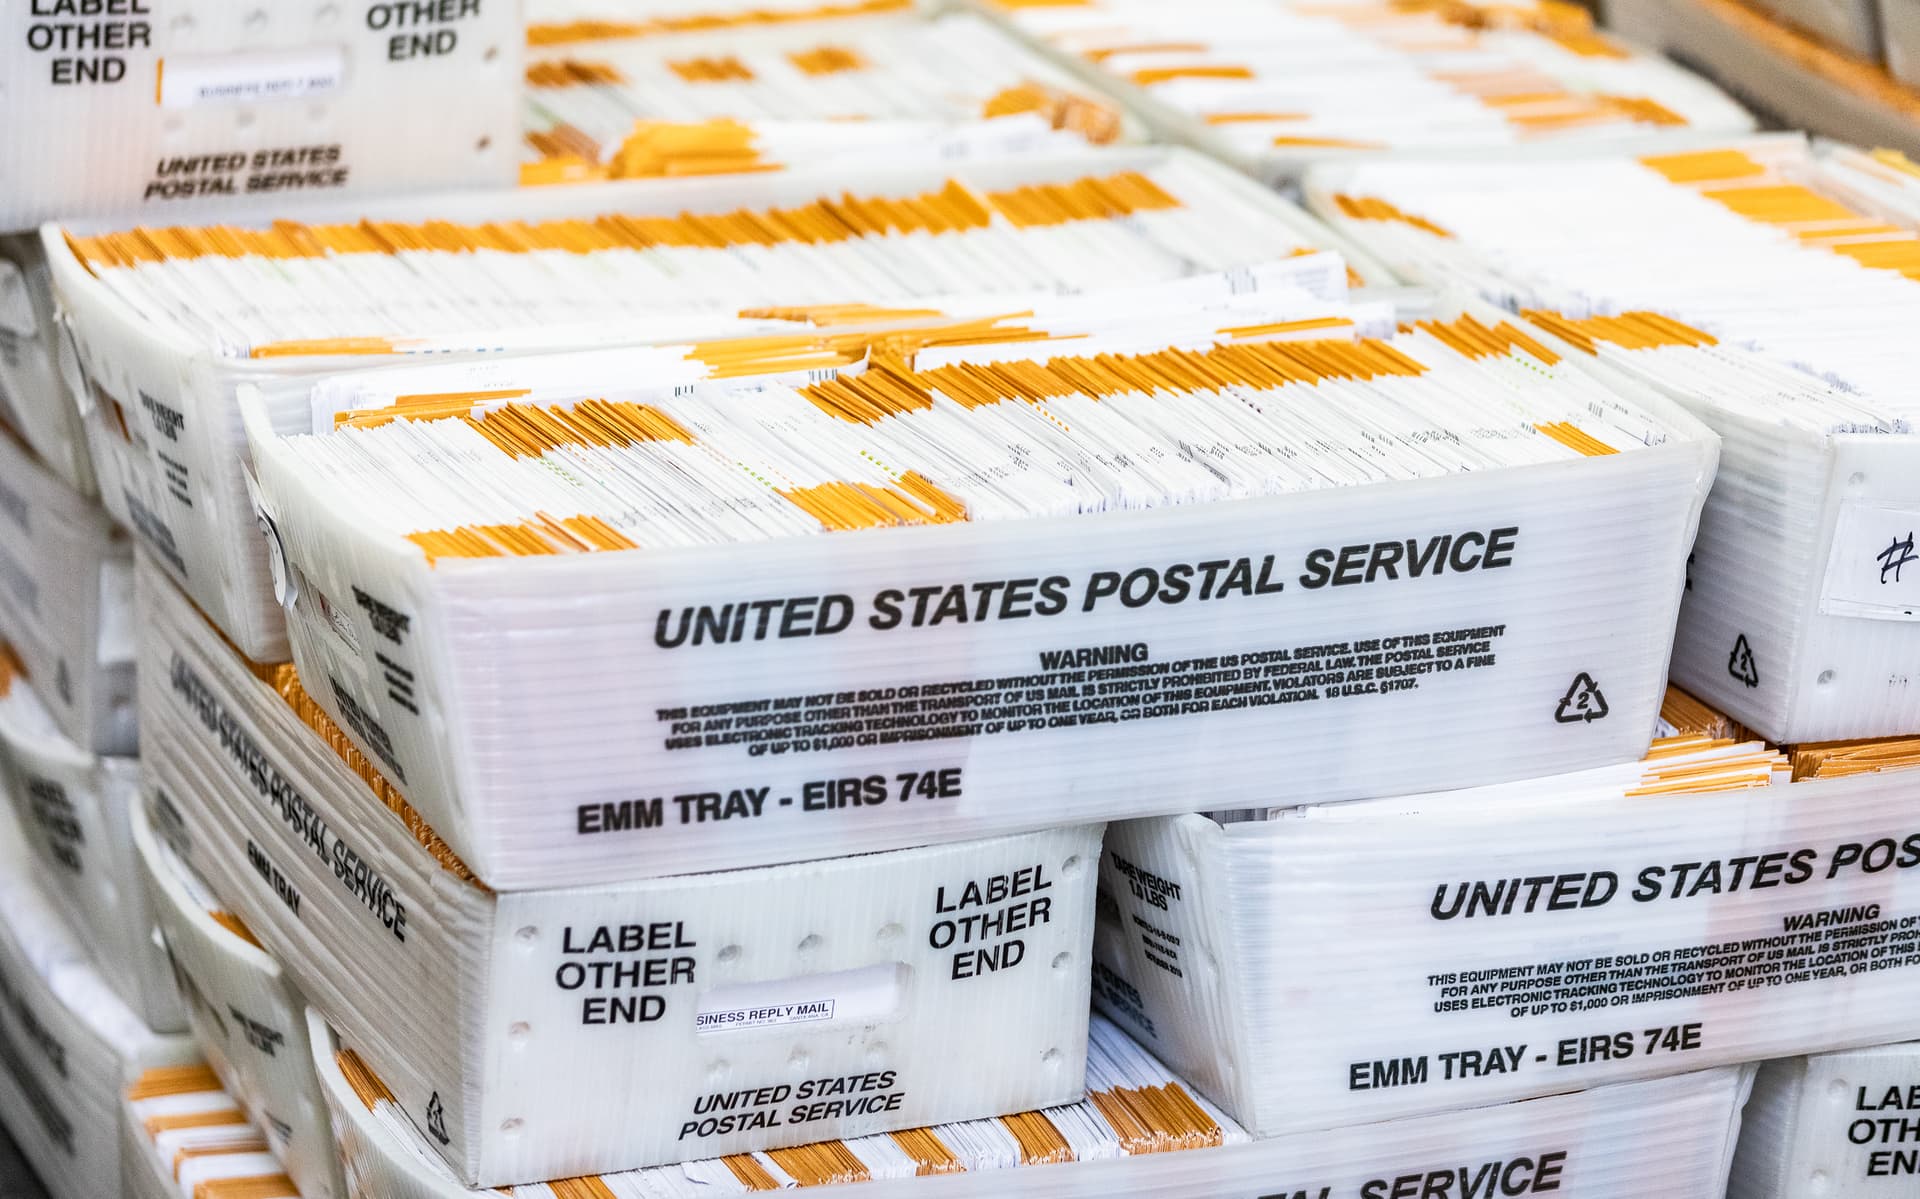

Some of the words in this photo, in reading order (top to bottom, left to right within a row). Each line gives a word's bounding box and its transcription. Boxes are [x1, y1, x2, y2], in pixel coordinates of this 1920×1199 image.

[27, 22, 152, 51] OTHER
[388, 29, 457, 61] END
[51, 57, 126, 84] END
[144, 177, 236, 200] POSTAL
[245, 166, 348, 194] SERVICE
[156, 152, 247, 177] UNITED
[252, 144, 341, 168] STATES
[1877, 531, 1919, 584] #
[655, 593, 853, 648] UNITED
[869, 576, 1070, 630] STATES
[1081, 555, 1284, 612] POSTAL
[1300, 526, 1518, 589] SERVICE
[1039, 643, 1148, 670] WARNING
[1171, 659, 1190, 672] OF
[1220, 654, 1238, 667] US
[1241, 648, 1291, 665] POSTAL
[1354, 638, 1380, 653] USE
[1382, 636, 1403, 650] OF
[672, 720, 700, 734] FOR
[703, 717, 732, 731] ANY
[735, 711, 801, 728] PURPOSE
[803, 707, 850, 722] OTHER
[1004, 690, 1023, 704] OF
[1025, 688, 1044, 702] US
[1098, 677, 1160, 695] STRICTLY
[1162, 668, 1240, 688] PROHIBITED
[1243, 666, 1262, 679] BY
[1264, 659, 1323, 677] FEDERAL
[1357, 653, 1382, 667] THE
[1385, 647, 1433, 664] POSTAL
[1436, 640, 1490, 658] SERVICE
[864, 711, 961, 732] TECHNOLOGY
[960, 710, 977, 723] TO
[1042, 701, 1070, 714] THE
[1072, 693, 1139, 711] LOCATION
[1141, 691, 1161, 704] OF
[1346, 668, 1373, 682] ARE
[1433, 659, 1452, 672] TO
[1454, 657, 1464, 670] A
[1466, 654, 1495, 668] FINE
[748, 743, 768, 756] OF
[770, 741, 790, 754] UP
[790, 739, 810, 752] TO
[855, 733, 877, 746] OR
[984, 721, 1004, 734] OF
[1007, 719, 1026, 732] UP
[1026, 717, 1046, 730] TO
[1142, 703, 1178, 718] BOTH
[1181, 700, 1209, 714] FOR
[1211, 696, 1246, 711] EACH
[1325, 686, 1339, 698] 18
[577, 798, 663, 834] EMM
[673, 787, 771, 824] TRAY
[779, 796, 793, 806] -
[802, 775, 887, 811] EIRS
[896, 768, 962, 801] 74E
[270, 777, 330, 866] POSTAL
[333, 837, 406, 943] SERVICE
[936, 864, 1052, 914] LABEL
[1135, 867, 1181, 901] WEIGHT
[1146, 885, 1168, 911] LBS
[1430, 870, 1618, 921] UNITED
[1631, 849, 1818, 902] STATES
[562, 921, 696, 954] LABEL
[929, 897, 1052, 949] OTHER
[1783, 904, 1880, 932] WARNING
[555, 956, 695, 990] OTHER
[951, 940, 1025, 980] END
[1427, 972, 1455, 985] THIS
[1459, 965, 1534, 983] EQUIPMENT
[1536, 962, 1563, 975] MAY
[1566, 959, 1592, 972] NOT
[1595, 957, 1612, 969] BE
[1615, 952, 1649, 967] SOLD
[1652, 950, 1670, 963] OR
[1674, 941, 1739, 960] RECYCLED
[1742, 933, 1798, 951] WITHOUT
[1798, 929, 1821, 943] THE
[1825, 918, 1897, 940] PERMISSION
[1900, 915, 1916, 928] OF
[1441, 985, 1467, 997] FOR
[1470, 982, 1497, 994] ANY
[1500, 976, 1561, 991] PURPOSE
[1564, 971, 1606, 985] OTHER
[1608, 966, 1645, 980] THAN
[1645, 963, 1668, 976] THE
[1671, 953, 1745, 973] TRANSPORT
[1748, 951, 1764, 963] OF
[1767, 948, 1783, 960] US
[1786, 944, 1815, 958] MAIL
[1818, 942, 1829, 953] IS
[1831, 933, 1888, 951] STRICTLY
[1434, 998, 1468, 1012] USES
[1471, 990, 1552, 1009] ELECTRONIC
[1553, 982, 1617, 1000] TRACKING
[1619, 971, 1704, 992] TECHNOLOGY
[1706, 969, 1722, 981] TO
[1725, 961, 1780, 979] MONITOR
[1782, 957, 1805, 970] THE
[1808, 947, 1868, 967] LOCATION
[1870, 944, 1887, 957] OF
[1890, 940, 1914, 954] THIS
[1510, 1005, 1528, 1018] OF
[1531, 1003, 1550, 1015] UP
[1550, 1001, 1566, 1013] TO
[1569, 997, 1607, 1013] $1,000
[1610, 994, 1628, 1007] OR
[1631, 982, 1725, 1004] IMPRISONMENT
[1728, 979, 1745, 992] OF
[1766, 974, 1781, 986] TO
[1785, 970, 1812, 983] ONE
[1812, 964, 1846, 981] YEAR,
[1850, 961, 1867, 974] OR
[1870, 956, 1902, 970] BOTH
[581, 995, 665, 1025] END
[749, 1006, 794, 1020] REPLY
[797, 1003, 829, 1015] MAIL
[1349, 1056, 1429, 1090] EMM
[1438, 1044, 1528, 1080] TRAY
[1556, 1030, 1634, 1067] EIRS
[1643, 1022, 1703, 1054] 74E
[694, 1083, 791, 1115] UNITED
[799, 1070, 897, 1101] STATES
[679, 1110, 789, 1141] POSTAL
[791, 1092, 904, 1127] SERVICE
